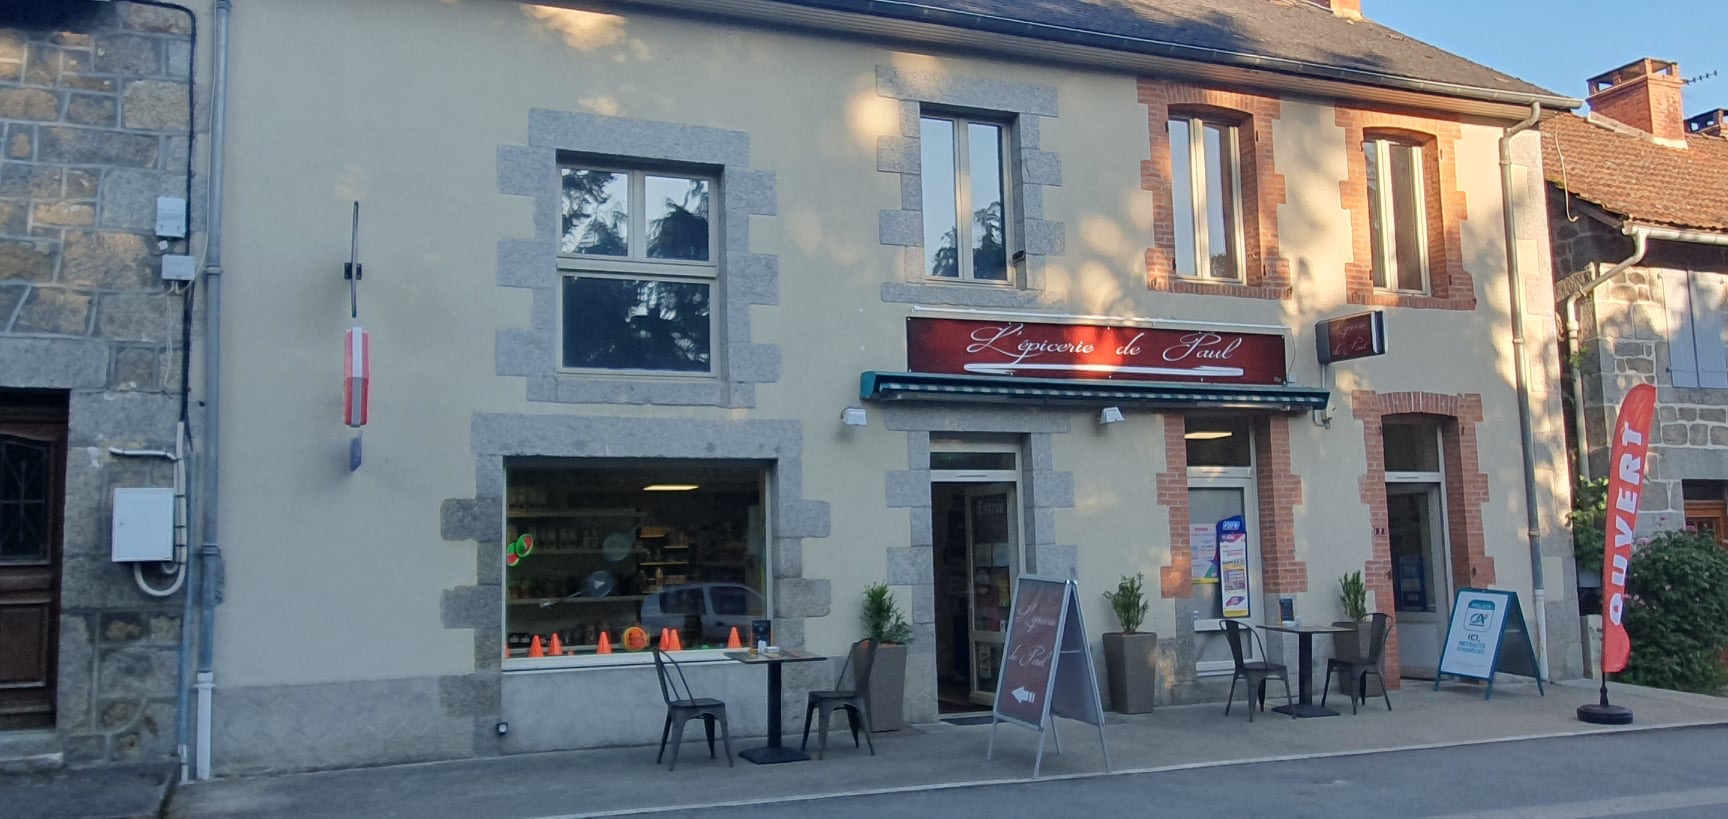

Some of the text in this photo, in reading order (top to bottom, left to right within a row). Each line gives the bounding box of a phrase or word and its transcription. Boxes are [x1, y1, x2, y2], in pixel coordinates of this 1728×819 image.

[966, 324, 1243, 365] L'épicerie de Paul
[1609, 421, 1643, 626] OUVERT
